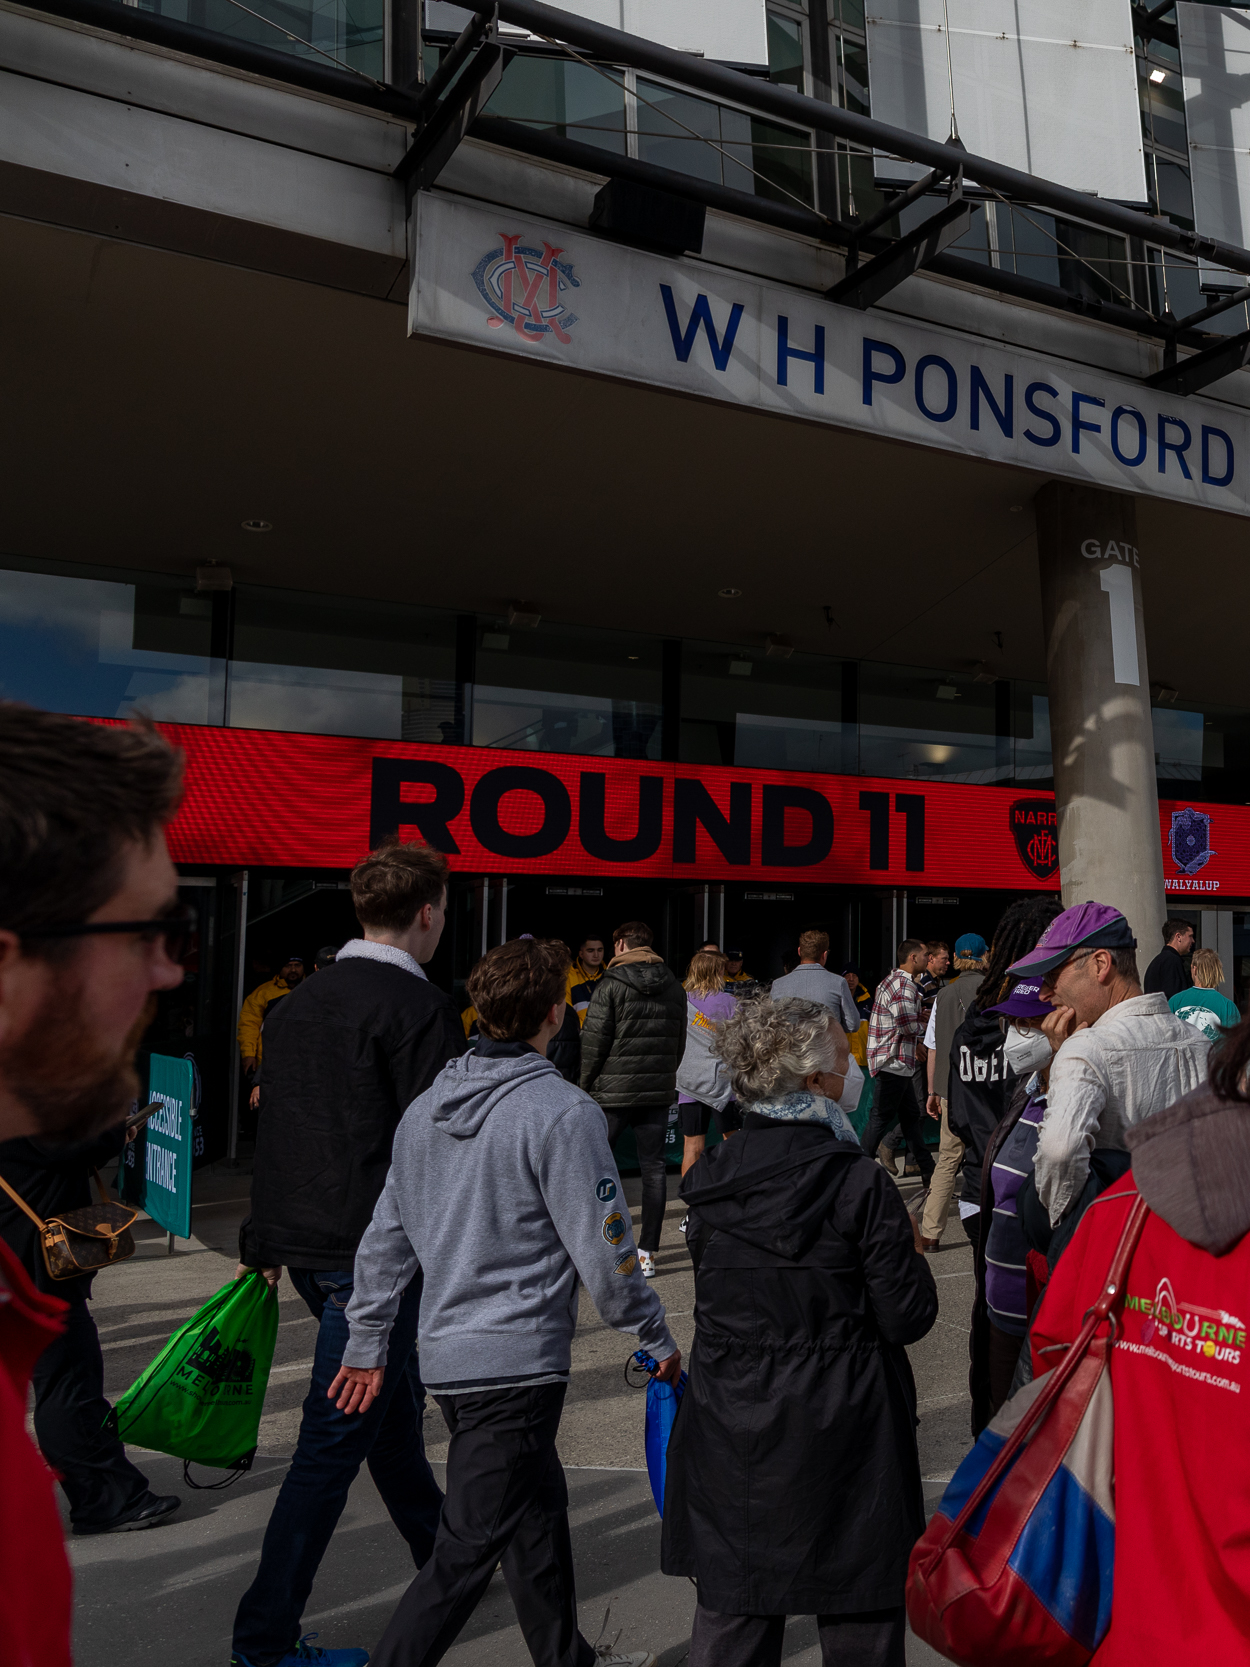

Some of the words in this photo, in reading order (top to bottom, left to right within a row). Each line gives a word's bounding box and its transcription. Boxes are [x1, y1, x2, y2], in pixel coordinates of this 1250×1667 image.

[660, 284, 745, 372] W
[777, 315, 826, 395] H
[862, 337, 1236, 488] PONSFORD
[1080, 538, 1140, 569] GATE
[1100, 563, 1141, 687] 1
[371, 756, 835, 868] ROUND
[858, 790, 926, 873] 11
[1014, 810, 1057, 826] NARR
[1164, 878, 1220, 891] WALYALUP
[1123, 1293, 1247, 1350] MELBOURNE
